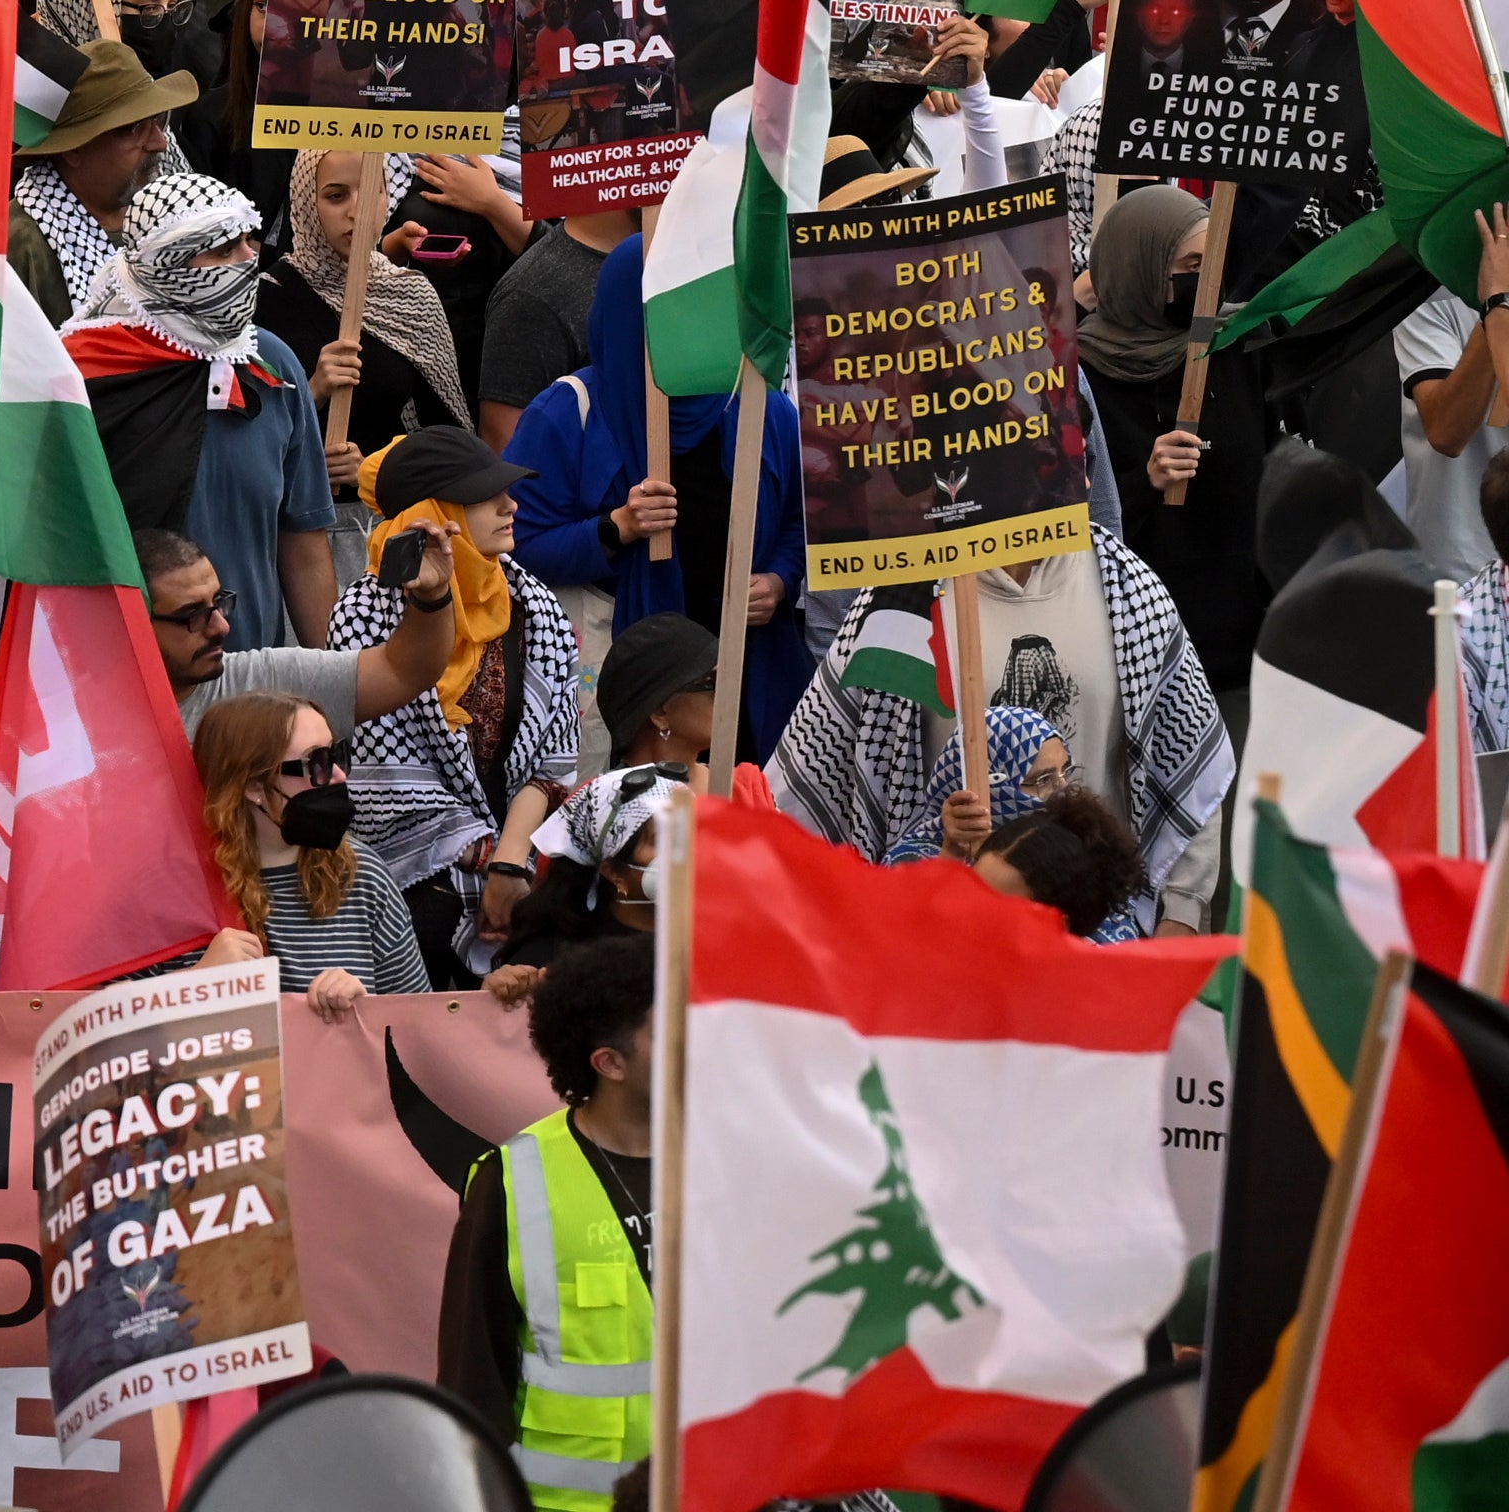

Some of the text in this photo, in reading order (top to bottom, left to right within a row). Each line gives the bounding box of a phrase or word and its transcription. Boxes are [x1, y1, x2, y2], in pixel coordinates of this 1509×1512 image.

[35, 974, 266, 1075] STAND WITH PALESTINE
[40, 1029, 253, 1128] GENOCIDE JOE'S
[43, 1071, 262, 1191] LEGACY:
[47, 1134, 266, 1243] THE BUTCHER
[51, 1185, 274, 1308] OF GAZA
[119, 1342, 293, 1400] AID TO ISRAEL
